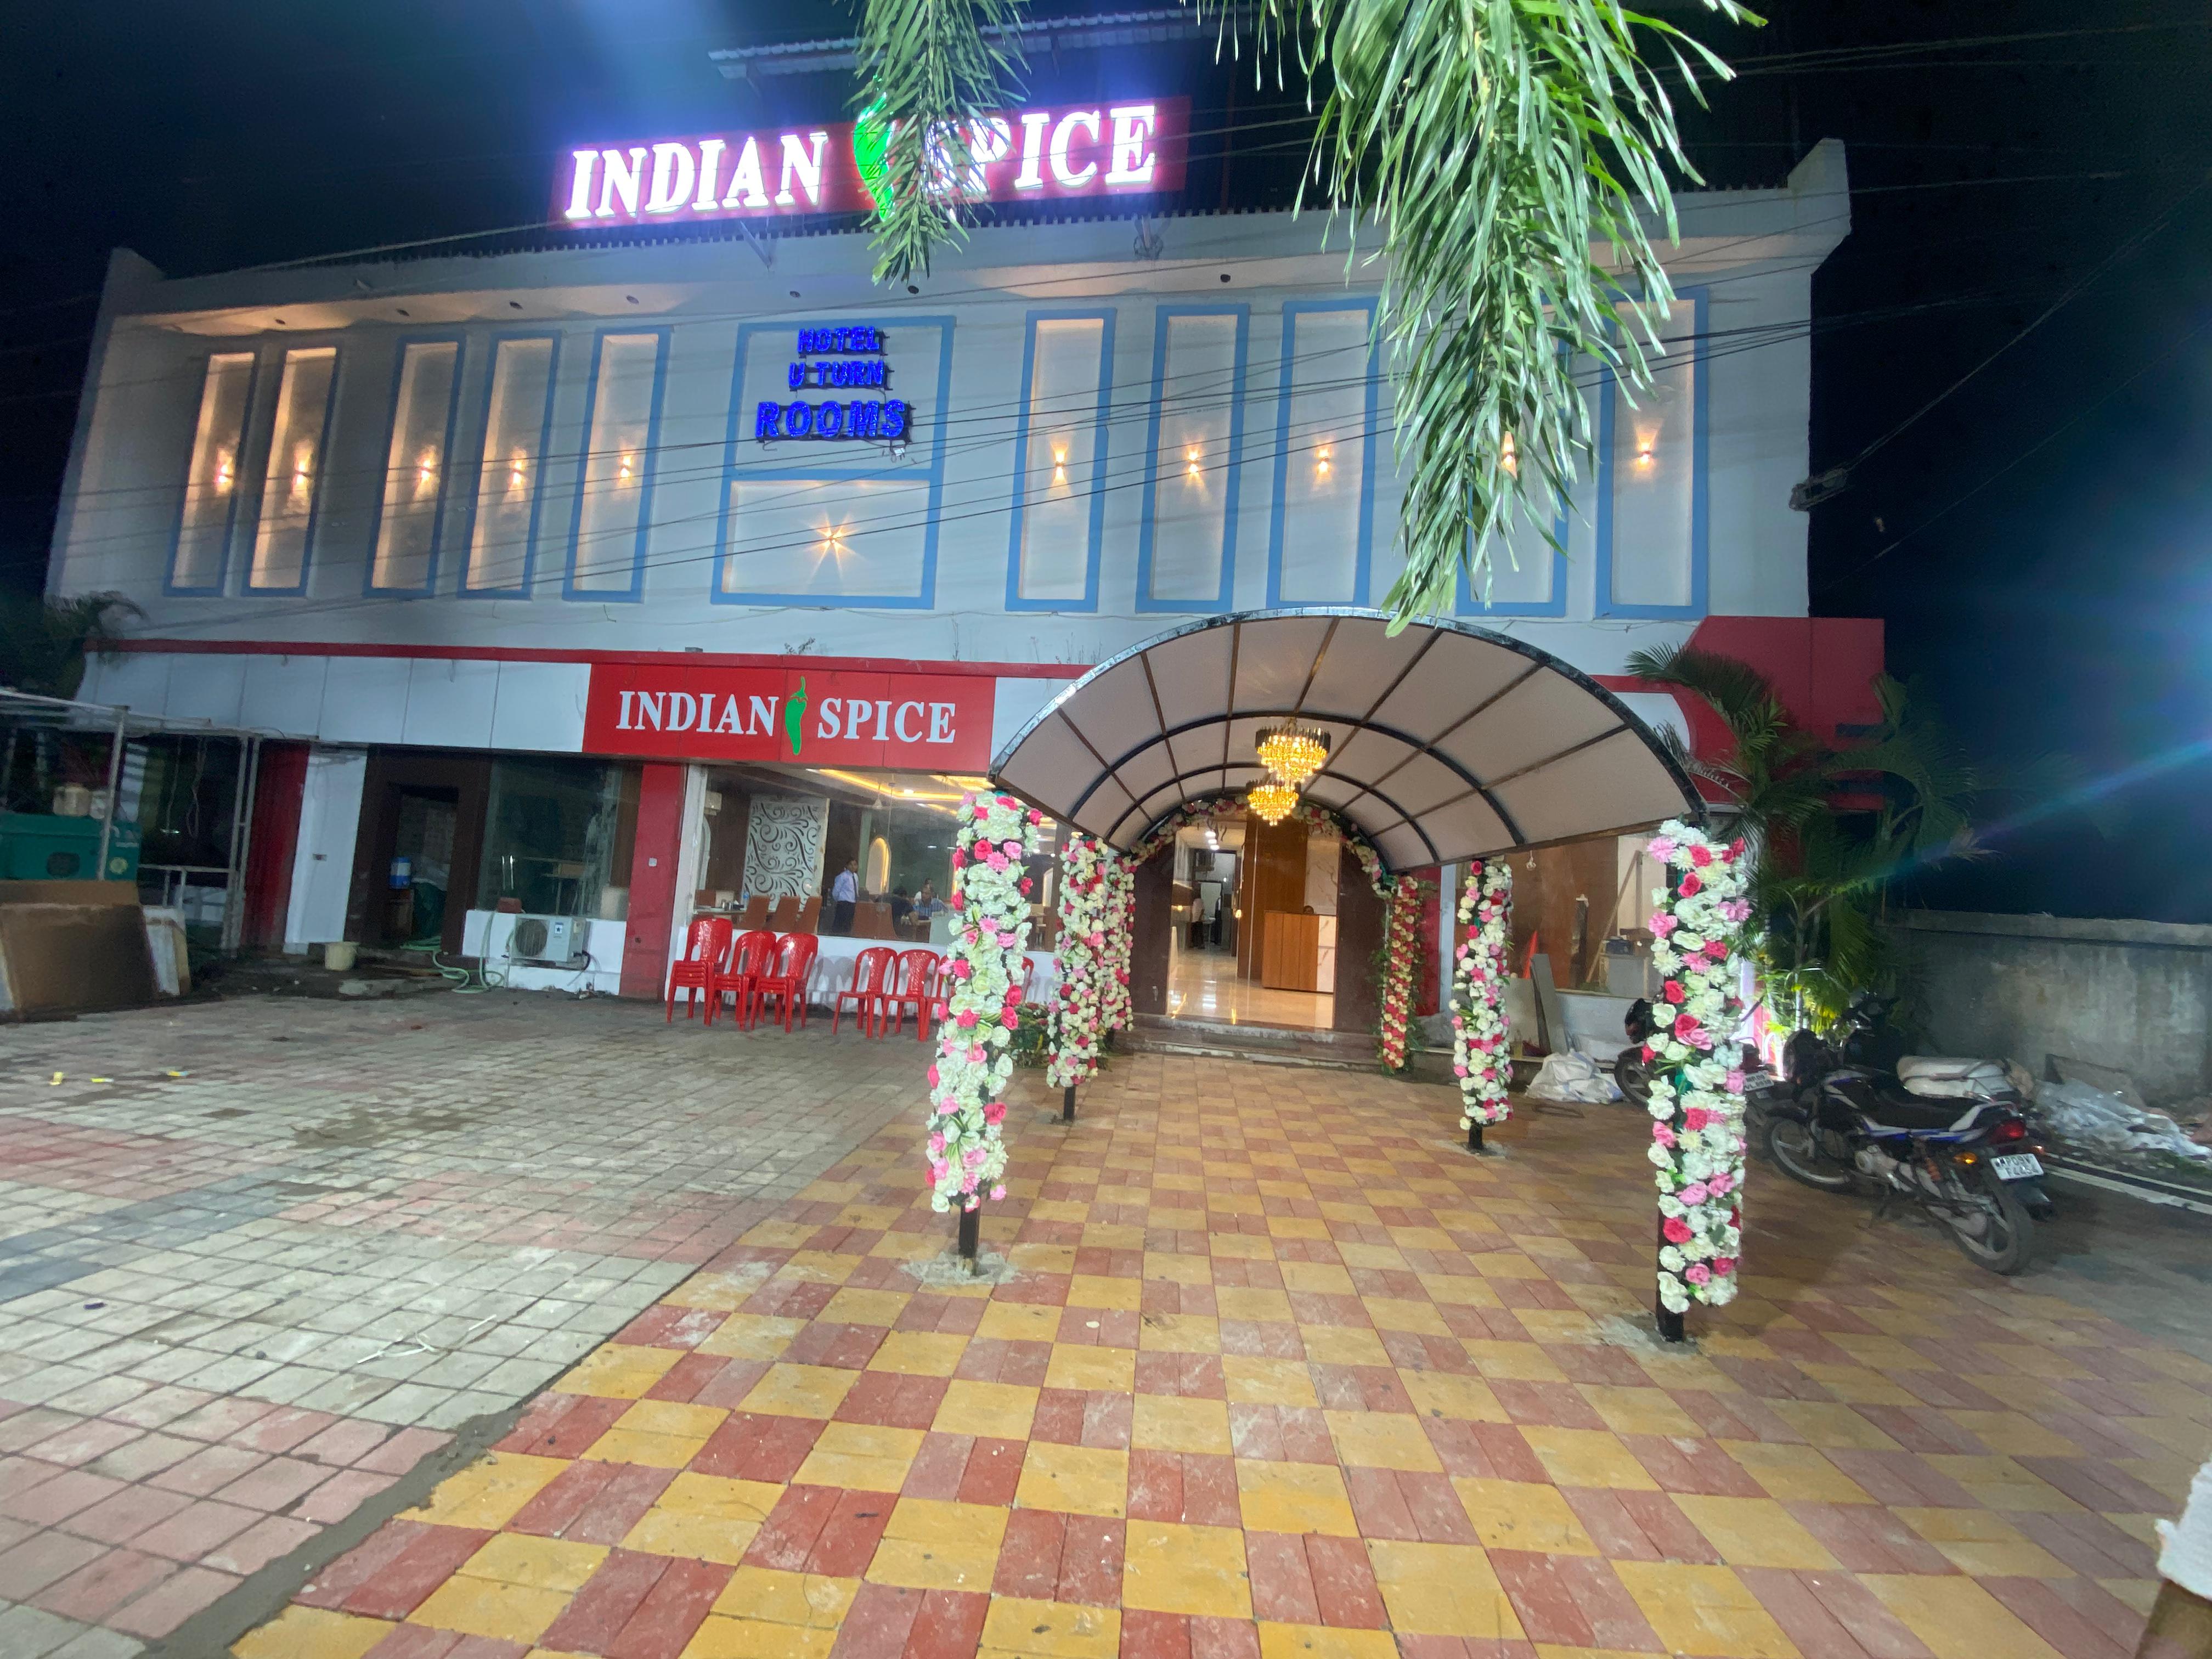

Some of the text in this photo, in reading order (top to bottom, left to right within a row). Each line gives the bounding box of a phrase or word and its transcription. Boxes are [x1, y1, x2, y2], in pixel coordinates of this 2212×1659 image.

[565, 131, 828, 218] INDIAN
[797, 326, 879, 352] HOTEL
[788, 360, 884, 387] U TURN
[755, 399, 905, 437] ROOMS
[616, 691, 956, 743] INDIAN SPICE
